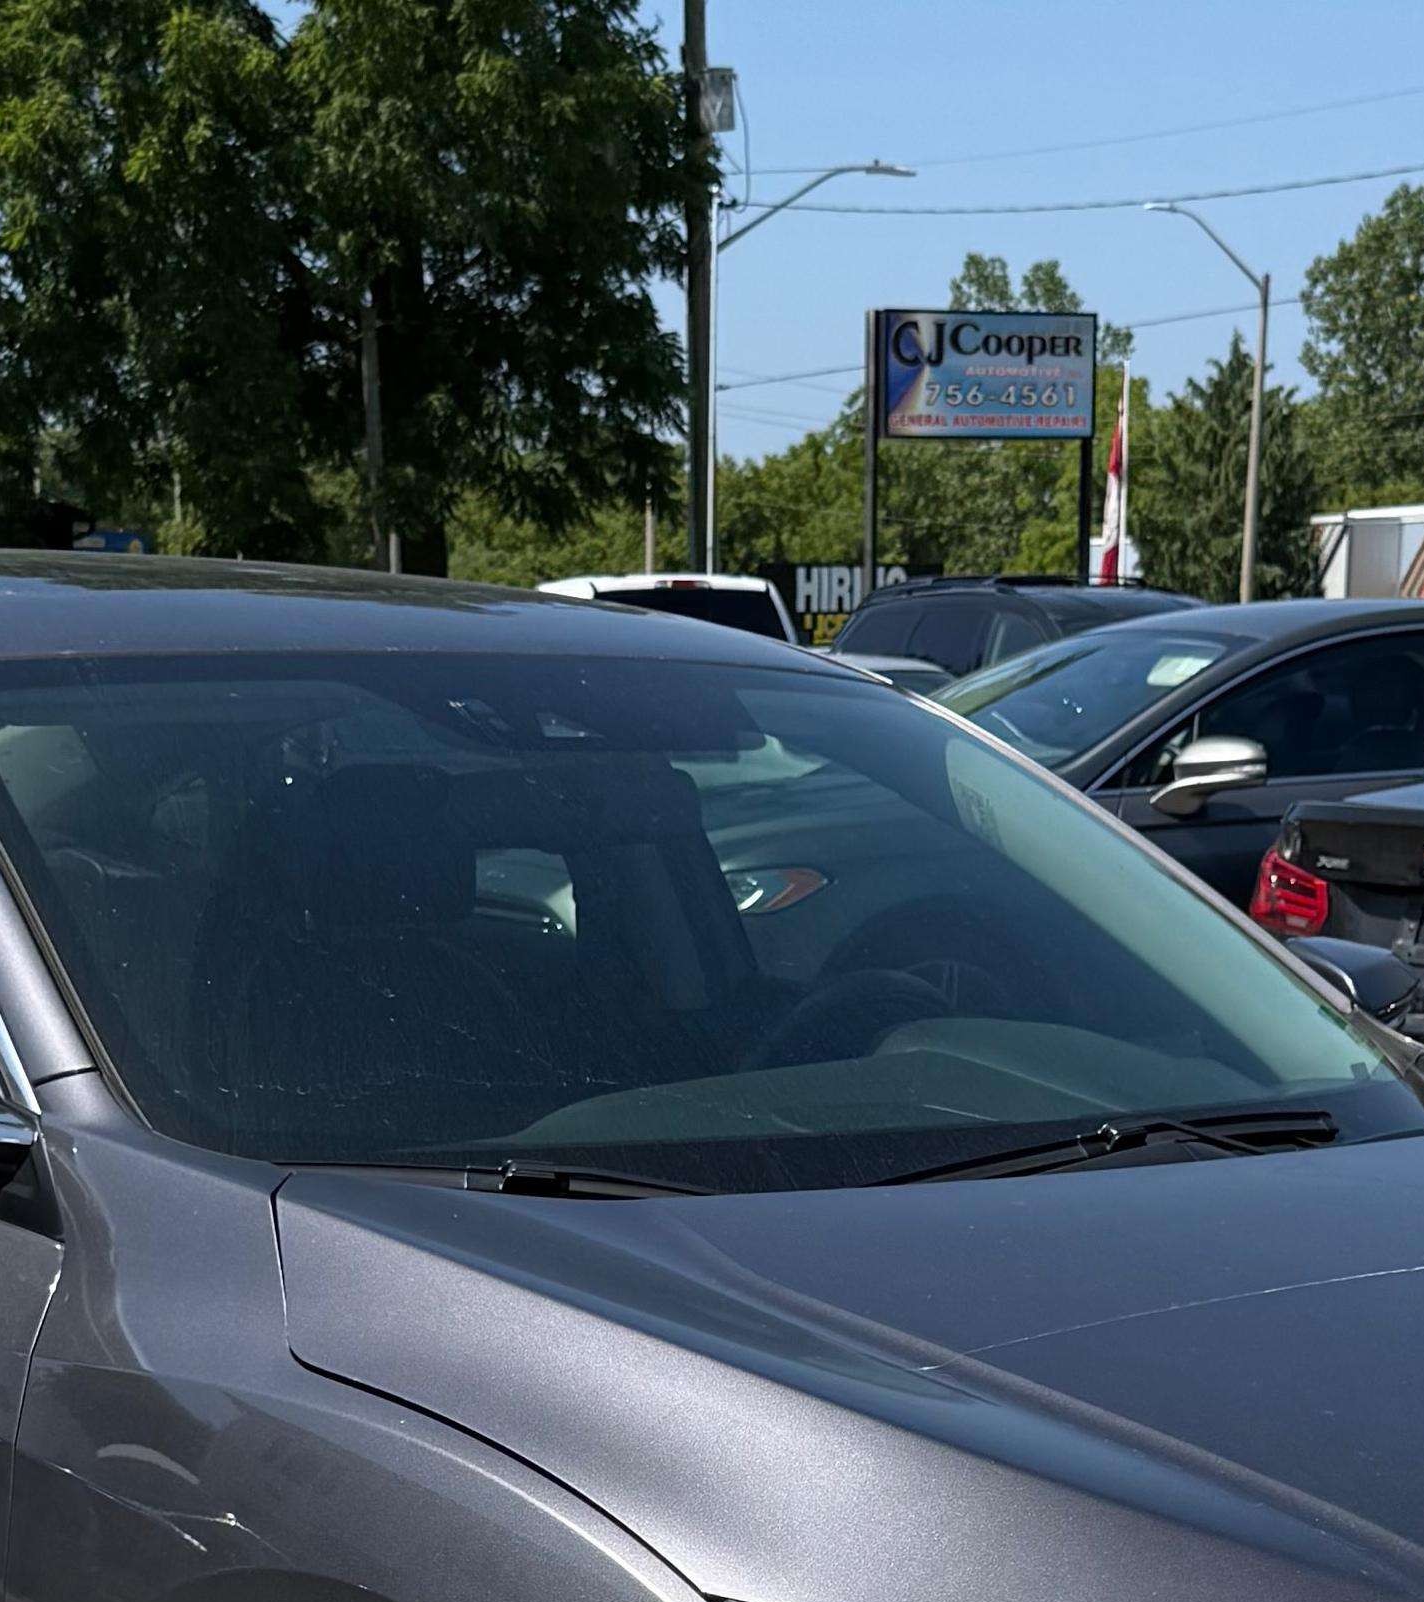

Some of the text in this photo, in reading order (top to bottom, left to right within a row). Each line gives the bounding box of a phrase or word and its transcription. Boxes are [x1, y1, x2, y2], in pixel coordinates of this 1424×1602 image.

[925, 382, 1077, 408] 756-4561
[889, 414, 948, 428] GENERAL
[952, 414, 1033, 428] AUTOMOTIVE
[795, 566, 907, 613] HIRI
